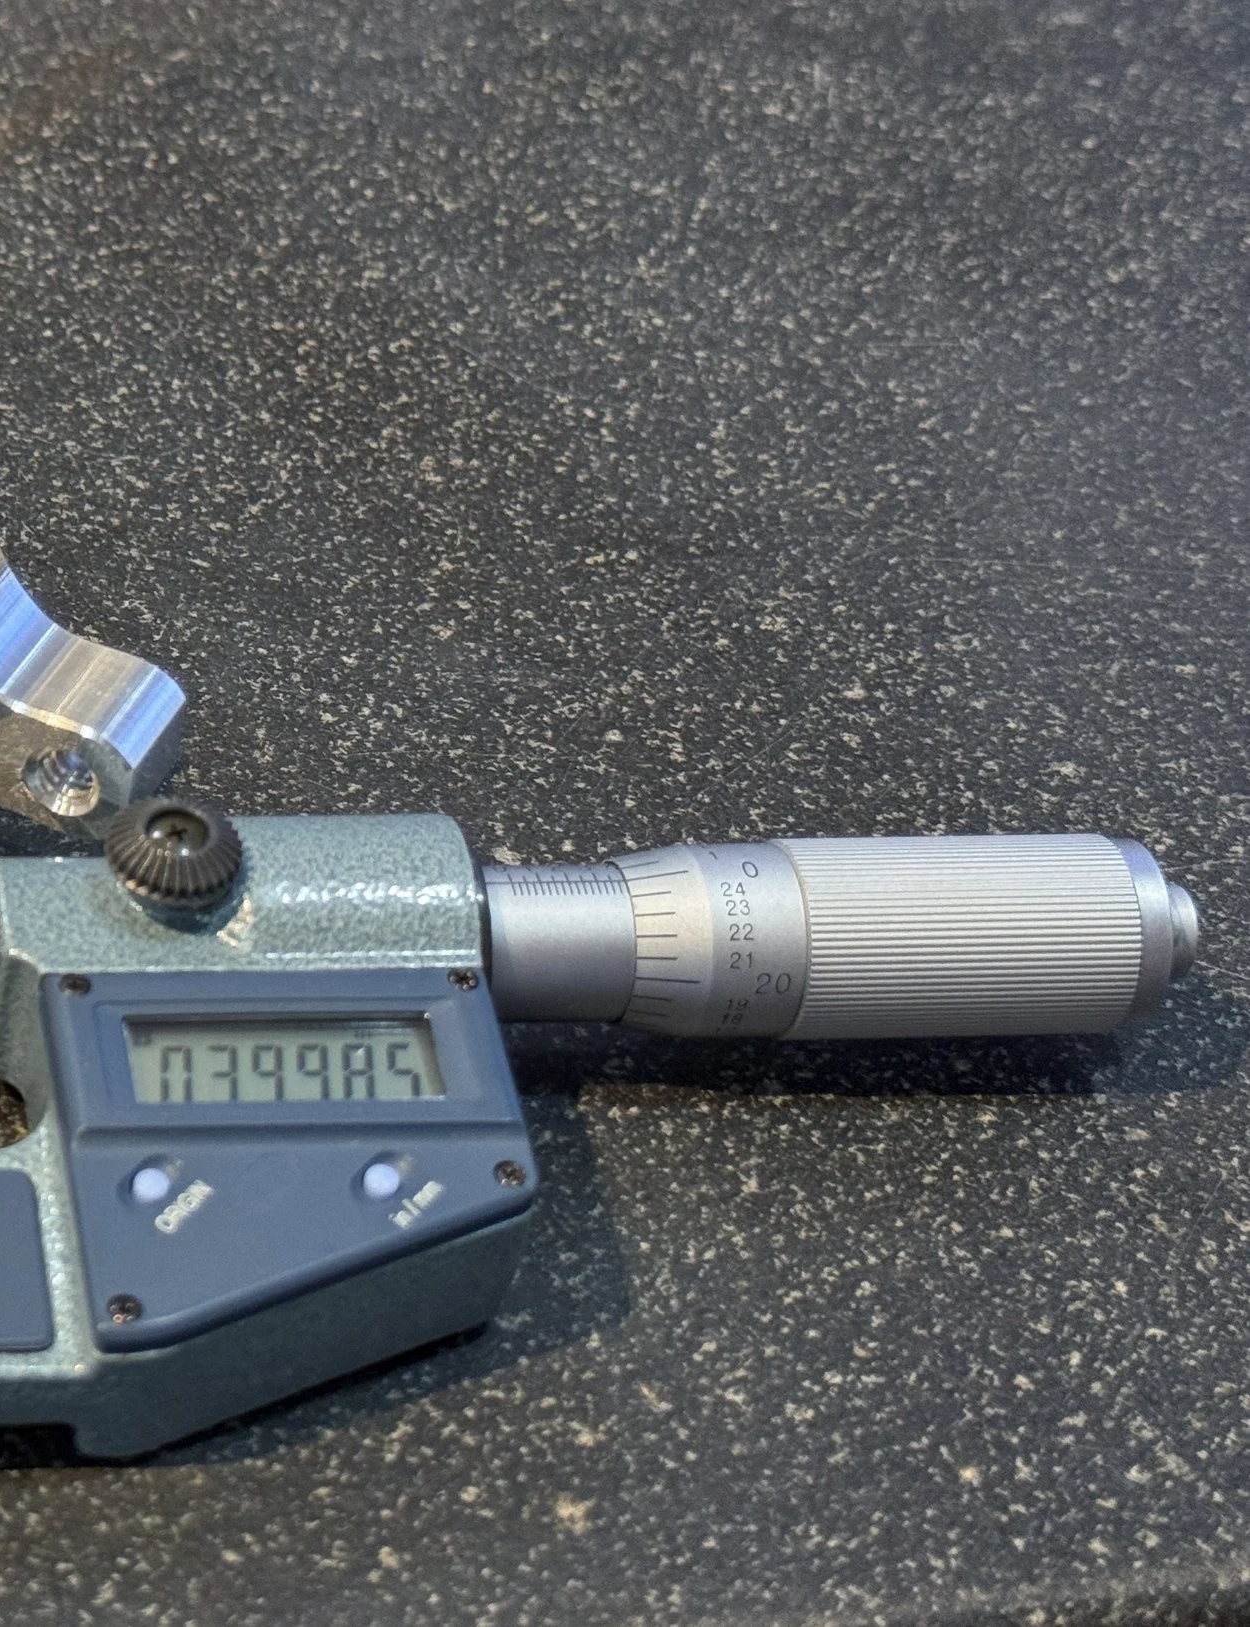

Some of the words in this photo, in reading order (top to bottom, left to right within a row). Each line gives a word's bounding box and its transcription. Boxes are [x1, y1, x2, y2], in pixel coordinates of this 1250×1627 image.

[741, 861, 759, 878] 0
[720, 881, 746, 897] 24
[725, 899, 751, 916] 23
[729, 923, 755, 941] 22
[729, 951, 753, 969] 21
[755, 972, 791, 995] 20
[726, 998, 748, 1011] 19
[721, 1012, 743, 1025] 18
